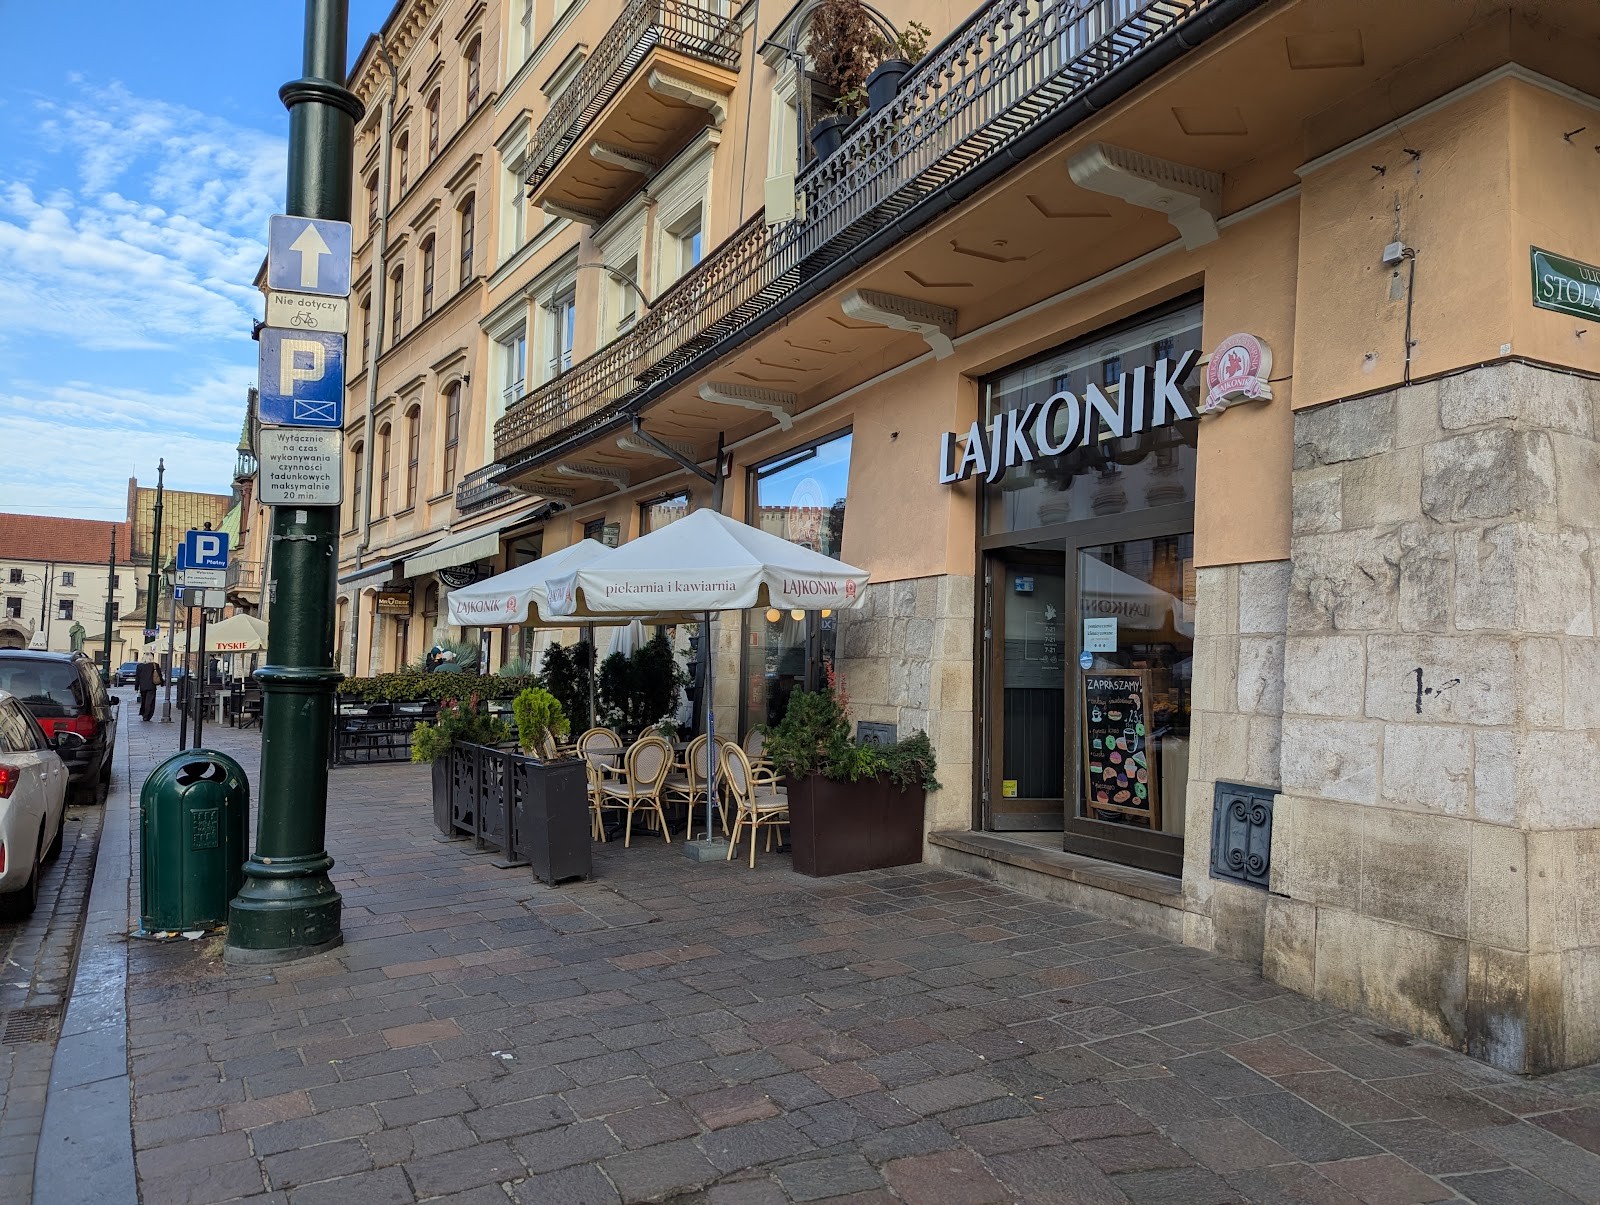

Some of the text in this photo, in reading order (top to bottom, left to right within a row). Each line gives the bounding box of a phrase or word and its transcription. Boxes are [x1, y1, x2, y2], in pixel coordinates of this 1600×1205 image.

[275, 295, 338, 312] Nie dotyczy
[280, 338, 325, 396] P
[939, 348, 1203, 485] LAJKONIK
[277, 433, 324, 443] Wyłącznie
[270, 453, 331, 462] wykonywania
[278, 463, 323, 472] czynności
[270, 472, 331, 482] ładunkowych
[271, 482, 330, 491] maksymalnie
[195, 534, 220, 564] P
[605, 580, 737, 597] piekarnia i kawiarnia
[783, 579, 838, 597] LAJKONIK
[456, 600, 501, 615] LAJKONIK
[215, 641, 248, 650] TYSKIE
